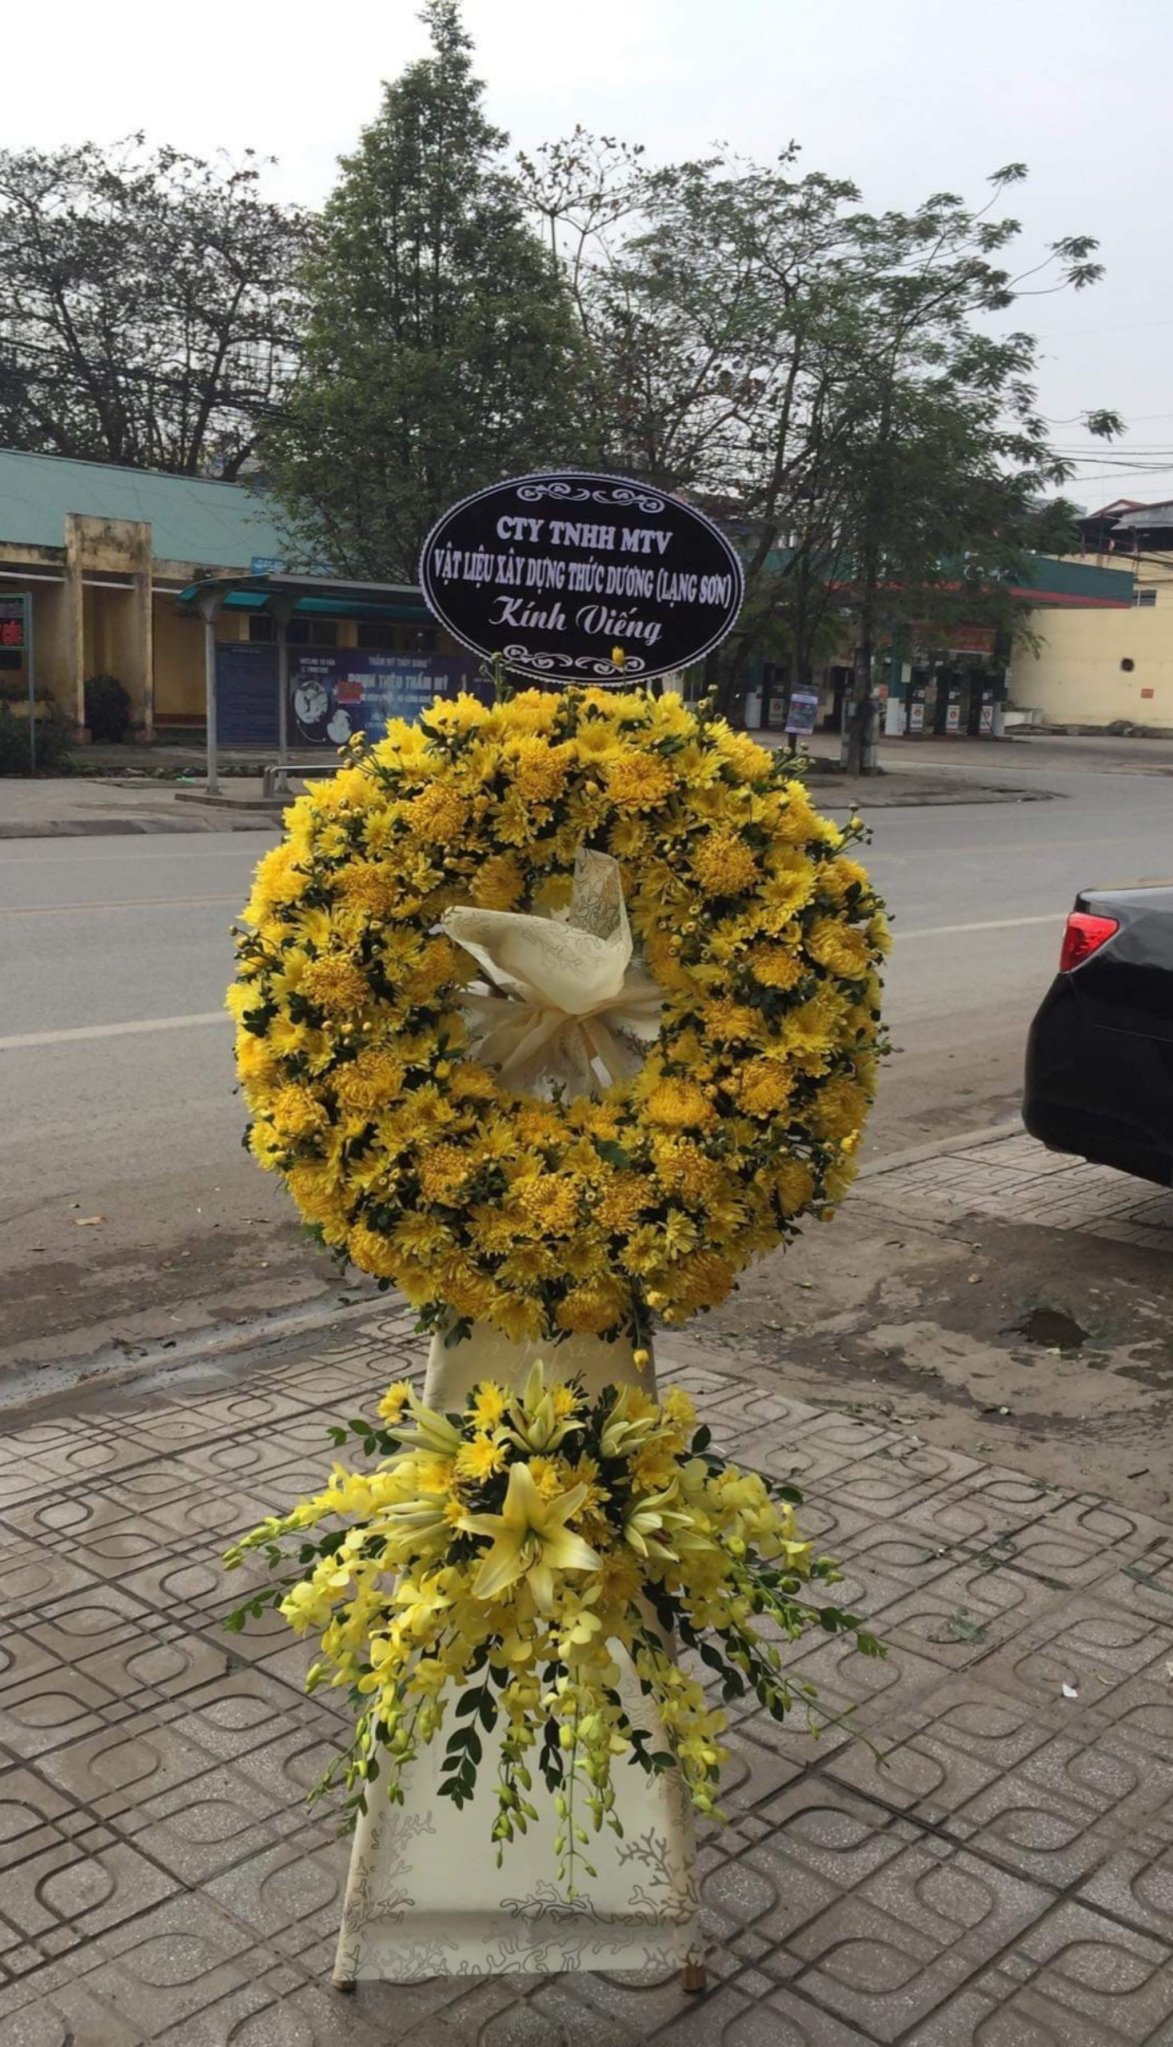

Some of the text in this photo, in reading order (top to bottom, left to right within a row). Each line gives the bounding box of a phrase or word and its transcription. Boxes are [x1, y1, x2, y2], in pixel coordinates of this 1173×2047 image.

[497, 515, 673, 555] CTY TNHH MTV
[434, 541, 732, 609] VẬT LIỆU XÂY DỰNG THỨC DƯƠNG (LẠNG SƠN)
[488, 595, 663, 646] Kính Viếng
